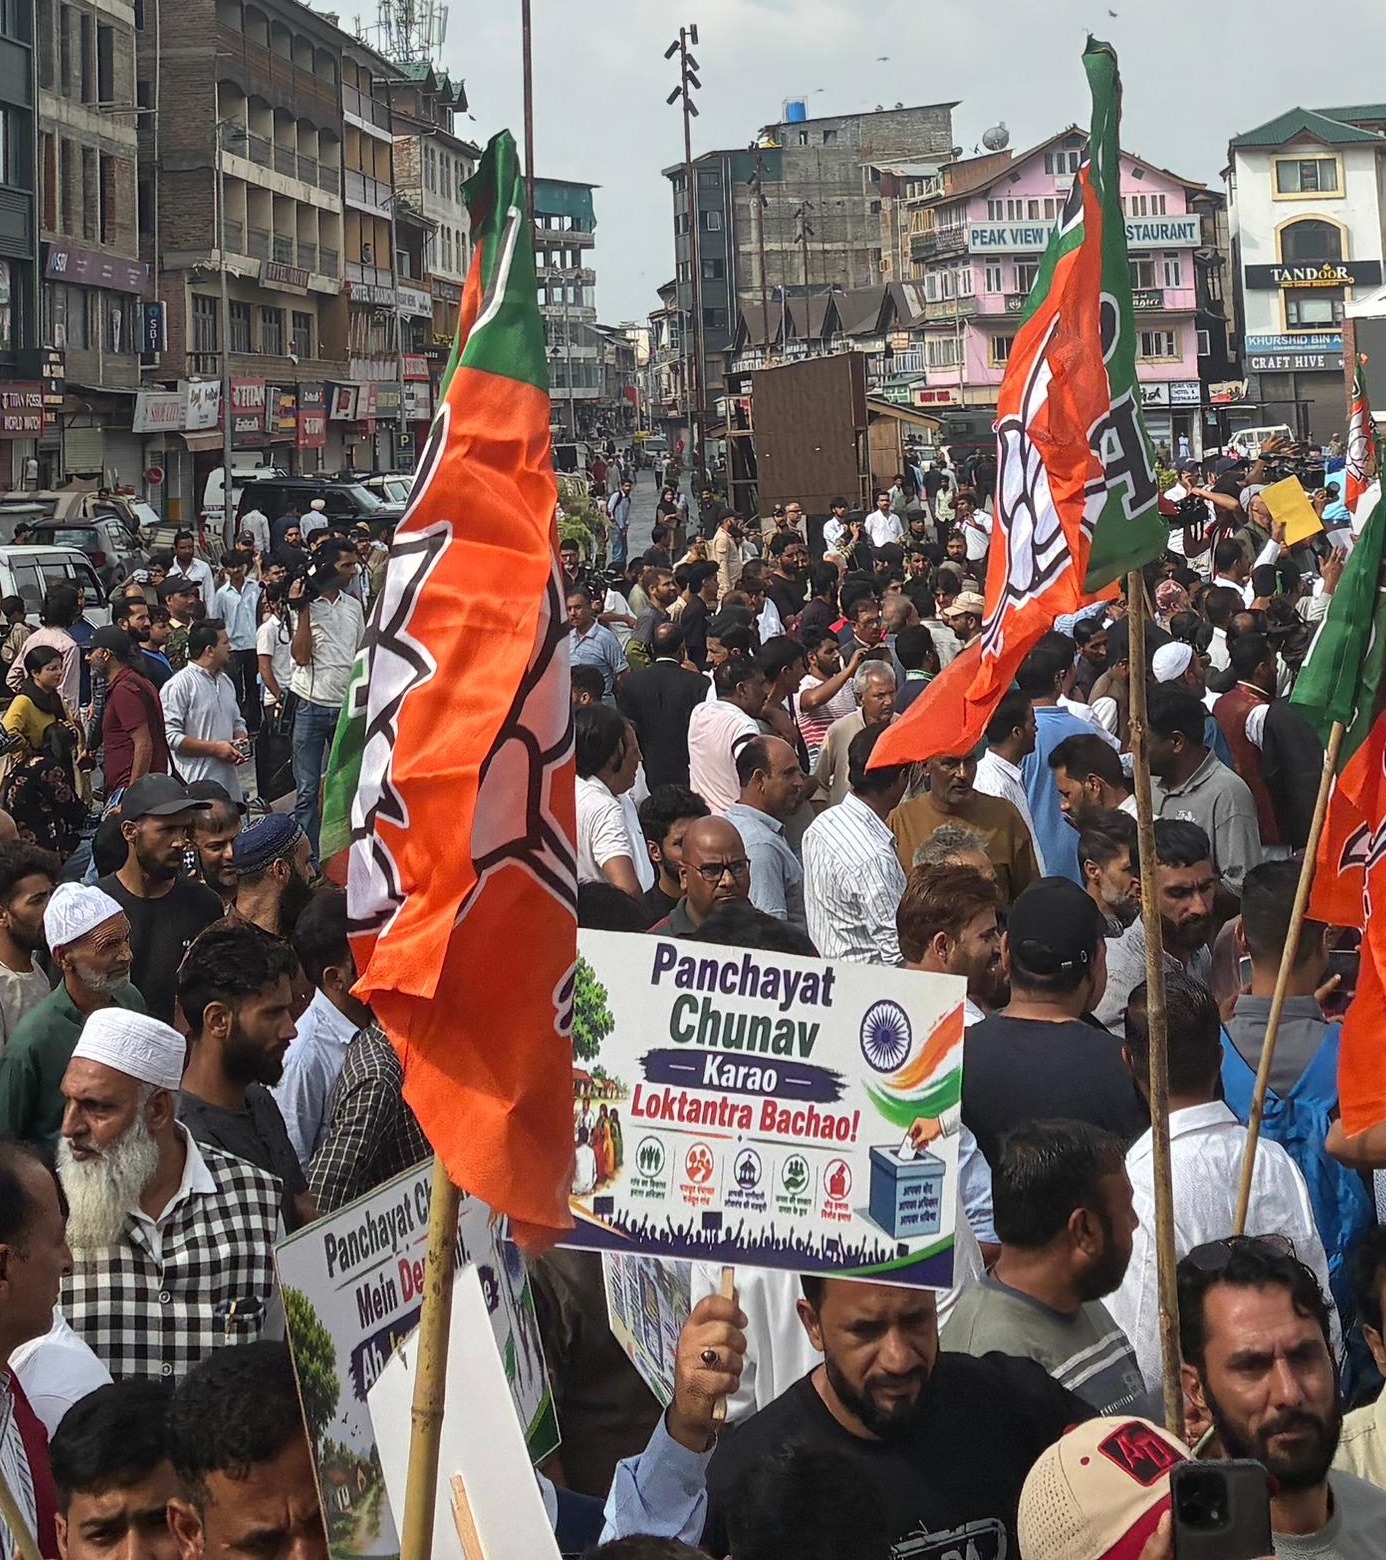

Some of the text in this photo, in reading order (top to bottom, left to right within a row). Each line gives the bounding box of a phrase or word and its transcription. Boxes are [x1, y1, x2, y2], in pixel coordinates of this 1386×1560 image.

[972, 222, 1196, 246] PEAK VIEW STAURANT
[1248, 334, 1343, 346] KHURSHID BIN A
[1252, 355, 1325, 369] CRAFT HIVE
[10, 393, 24, 408] TITAN
[4, 416, 41, 430] WORLD WATCH
[400, 434, 409, 446] P
[651, 943, 836, 1012] Panchayat
[670, 994, 821, 1059] Chunav
[703, 1054, 778, 1093] Karao
[631, 1085, 861, 1142] Loktantra Bachao!
[325, 1194, 414, 1278] Panchayat
[356, 1277, 397, 1329] Mein
